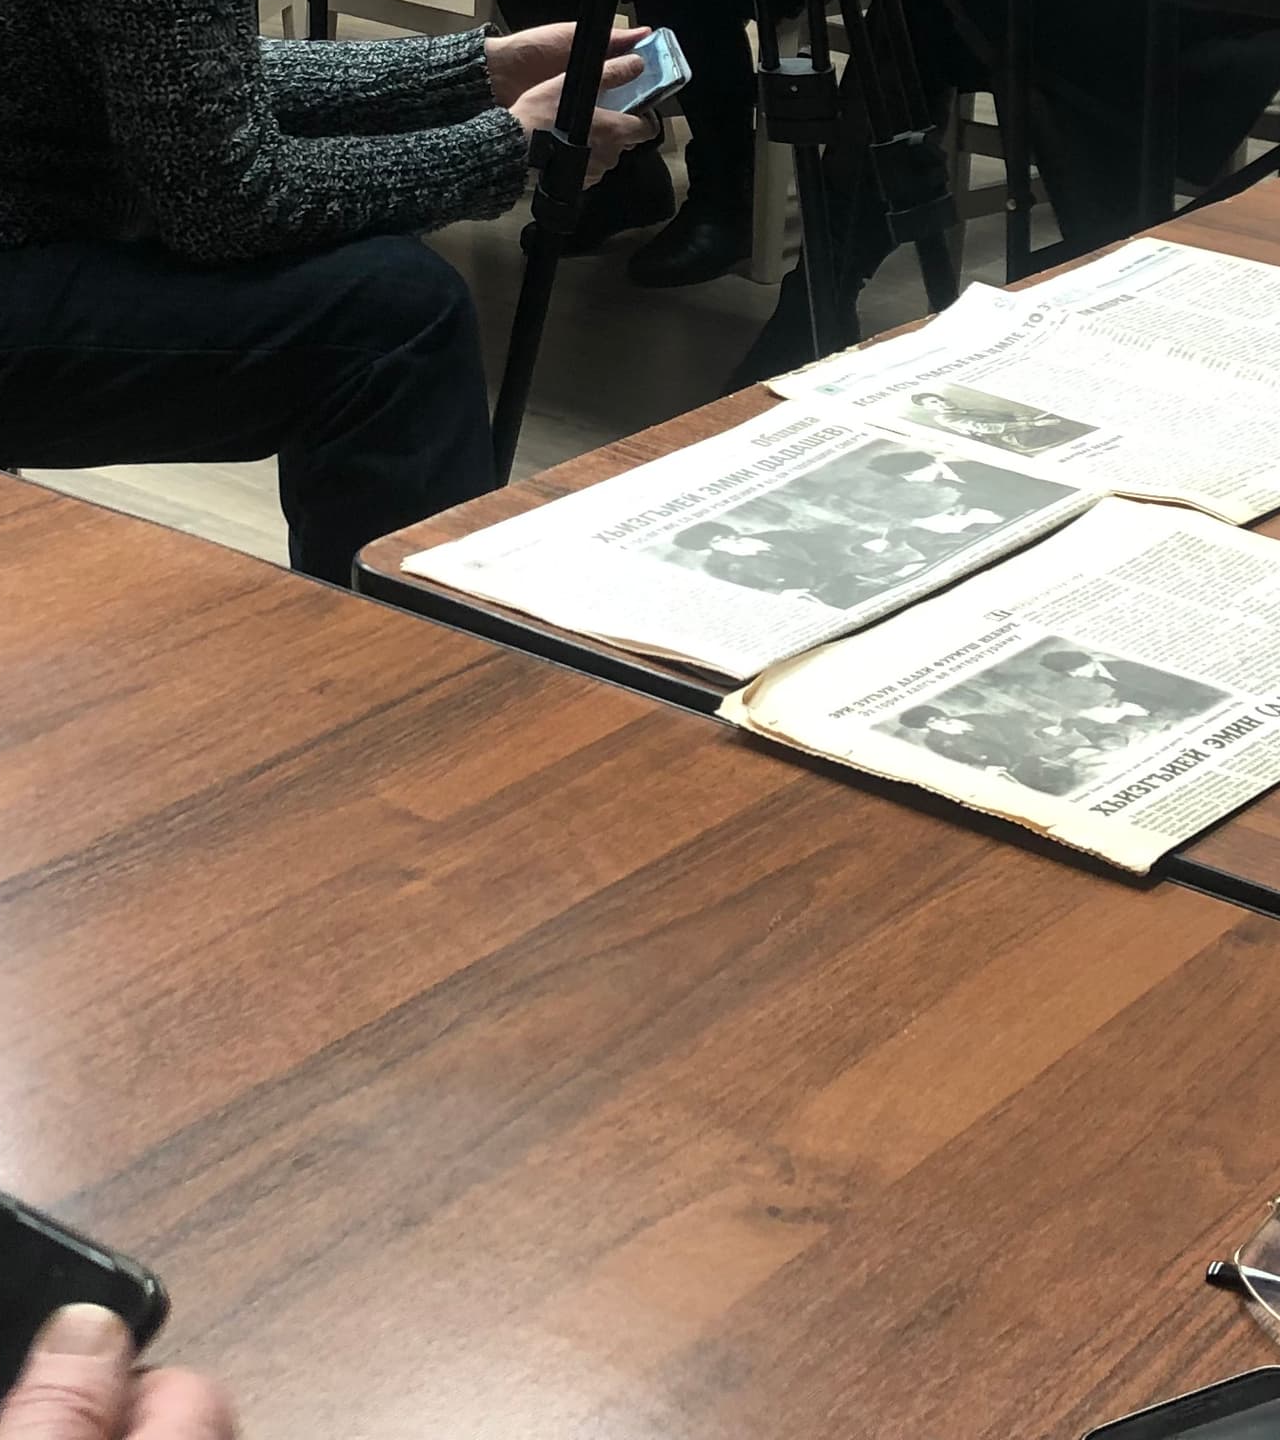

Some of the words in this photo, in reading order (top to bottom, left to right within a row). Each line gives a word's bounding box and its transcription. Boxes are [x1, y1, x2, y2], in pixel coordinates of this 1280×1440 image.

[1022, 312, 1044, 334] ТО
[751, 416, 820, 447] Община
[698, 468, 760, 496] ЭМИН
[752, 425, 854, 473] (ДАДАШЕВ)
[1203, 715, 1265, 750] ЭМИН
